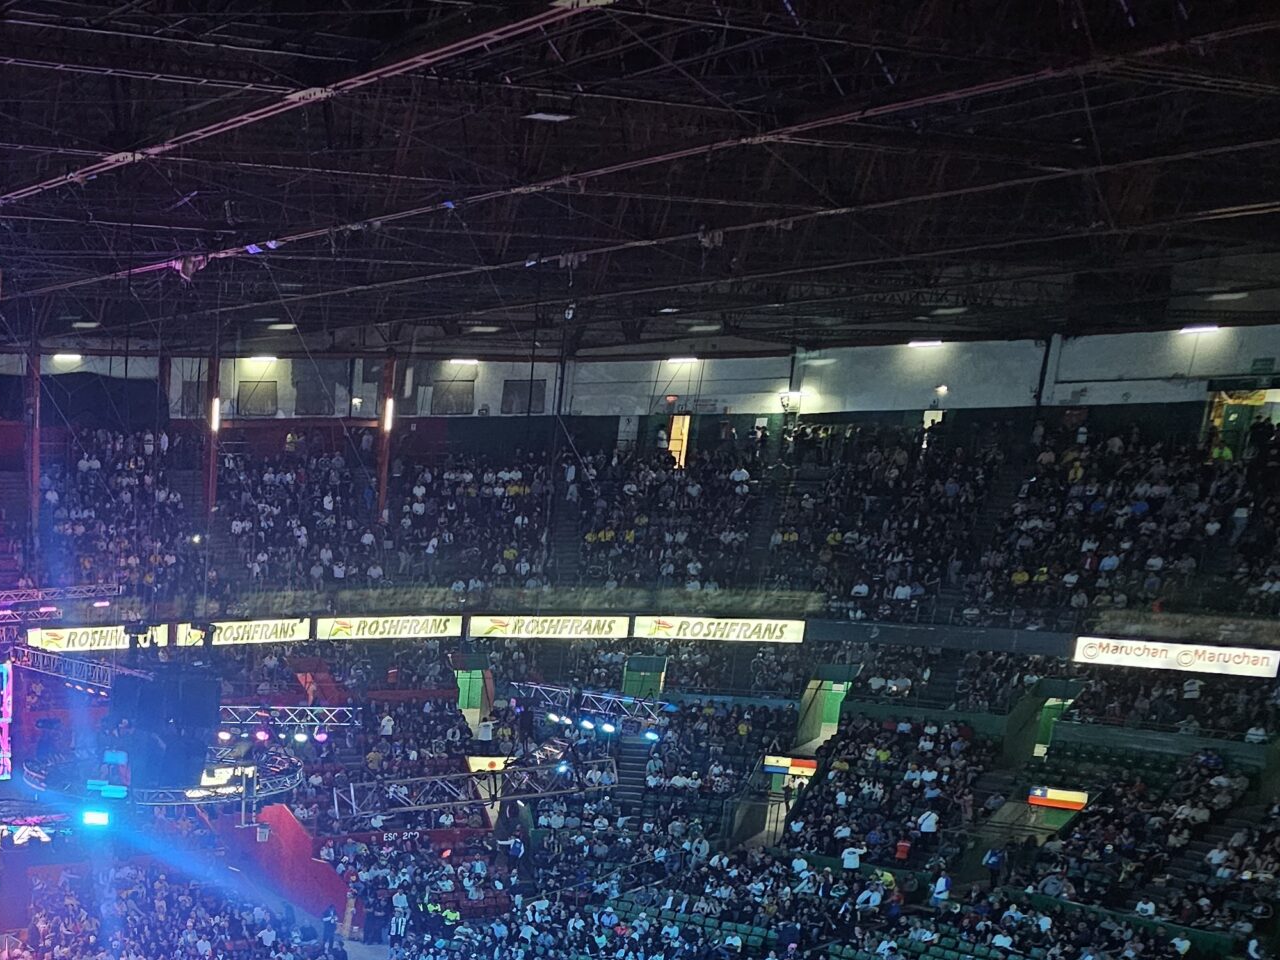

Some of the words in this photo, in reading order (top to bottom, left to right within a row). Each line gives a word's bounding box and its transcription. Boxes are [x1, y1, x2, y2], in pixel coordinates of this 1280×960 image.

[213, 622, 297, 643] ROSHFRANS
[355, 618, 450, 636] ROSHFRANS
[511, 618, 616, 636] ROSHFRANS
[676, 620, 788, 640] ROSHFRANS
[1097, 642, 1168, 659] Maruchan
[1193, 649, 1270, 667] Maruchan
